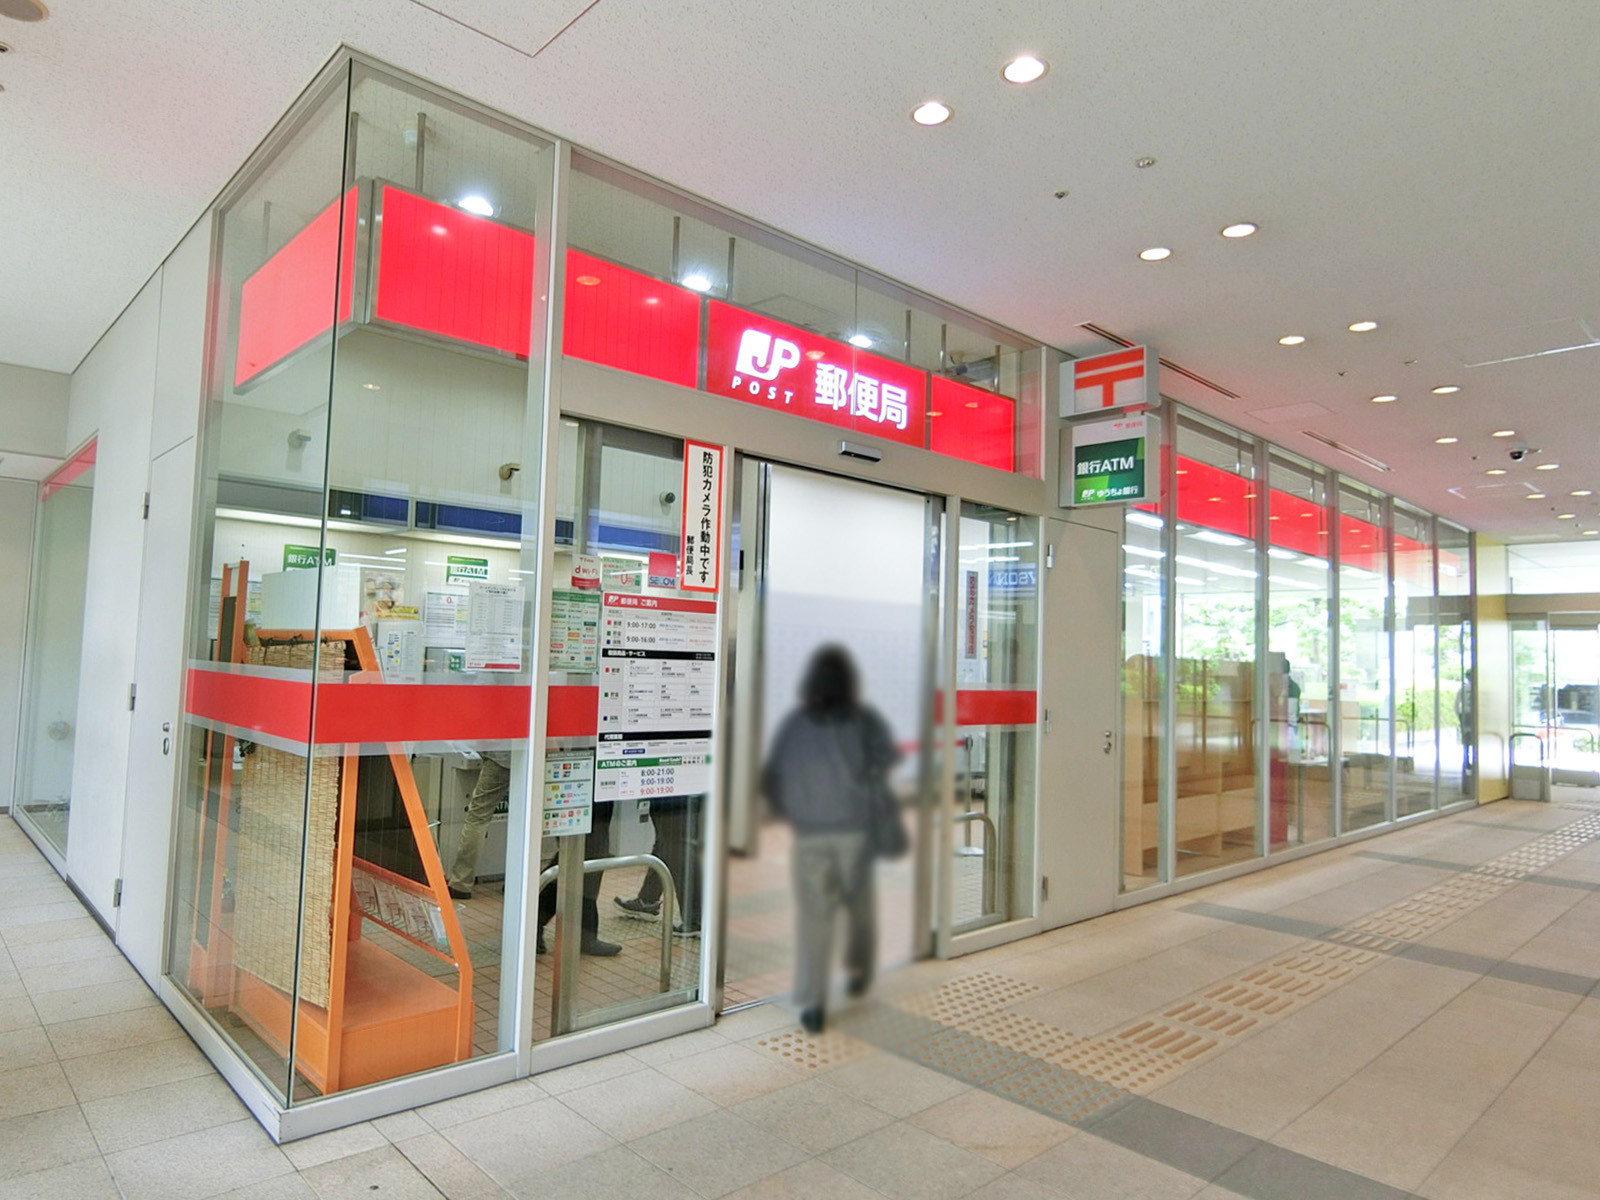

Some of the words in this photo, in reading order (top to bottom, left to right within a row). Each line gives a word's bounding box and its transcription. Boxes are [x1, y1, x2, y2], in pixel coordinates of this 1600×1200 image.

[731, 375, 793, 404] POST
[814, 362, 908, 430] 郵便局
[1076, 456, 1135, 476] 銀行ATM
[1097, 485, 1139, 498] ゆうちょ銀行
[699, 451, 713, 583] 防犯カメラ作動中です
[686, 535, 695, 575] 郵便局長
[627, 621, 657, 629] 9:00-17:00
[641, 768, 675, 777] 8:00-21:00
[641, 777, 675, 786] 9:00-19:00
[640, 786, 674, 795] 9:00-19:00
